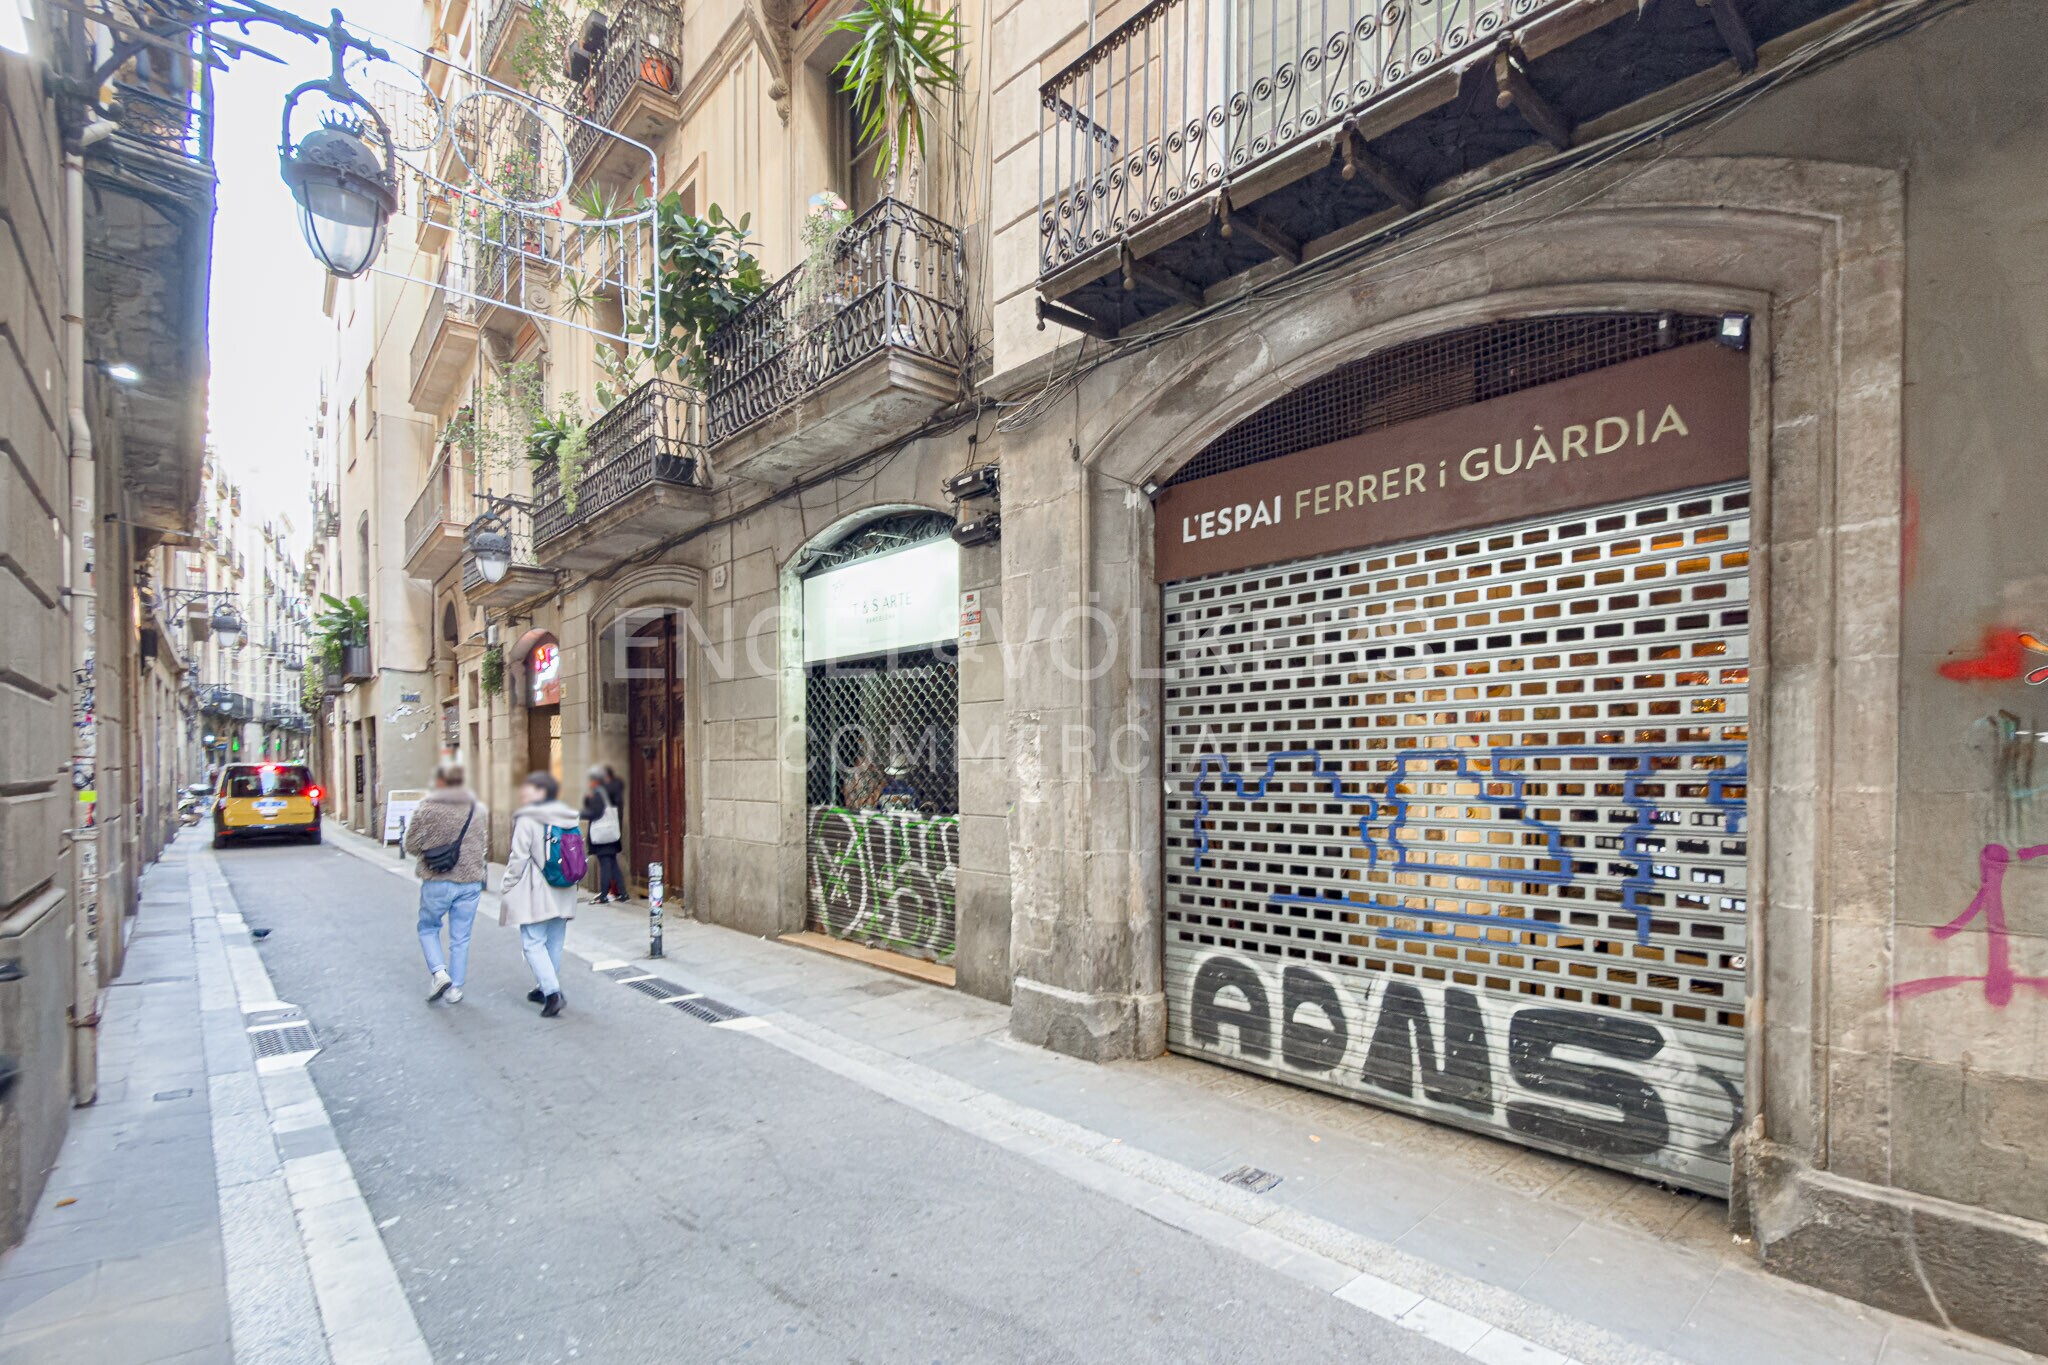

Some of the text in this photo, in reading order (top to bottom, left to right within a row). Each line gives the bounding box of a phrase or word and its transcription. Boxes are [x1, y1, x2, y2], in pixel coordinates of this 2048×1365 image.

[1182, 403, 1689, 544] L'ESPAI FERRER i GUÀRDIA
[872, 598, 879, 612] S
[883, 592, 912, 609] ARTE
